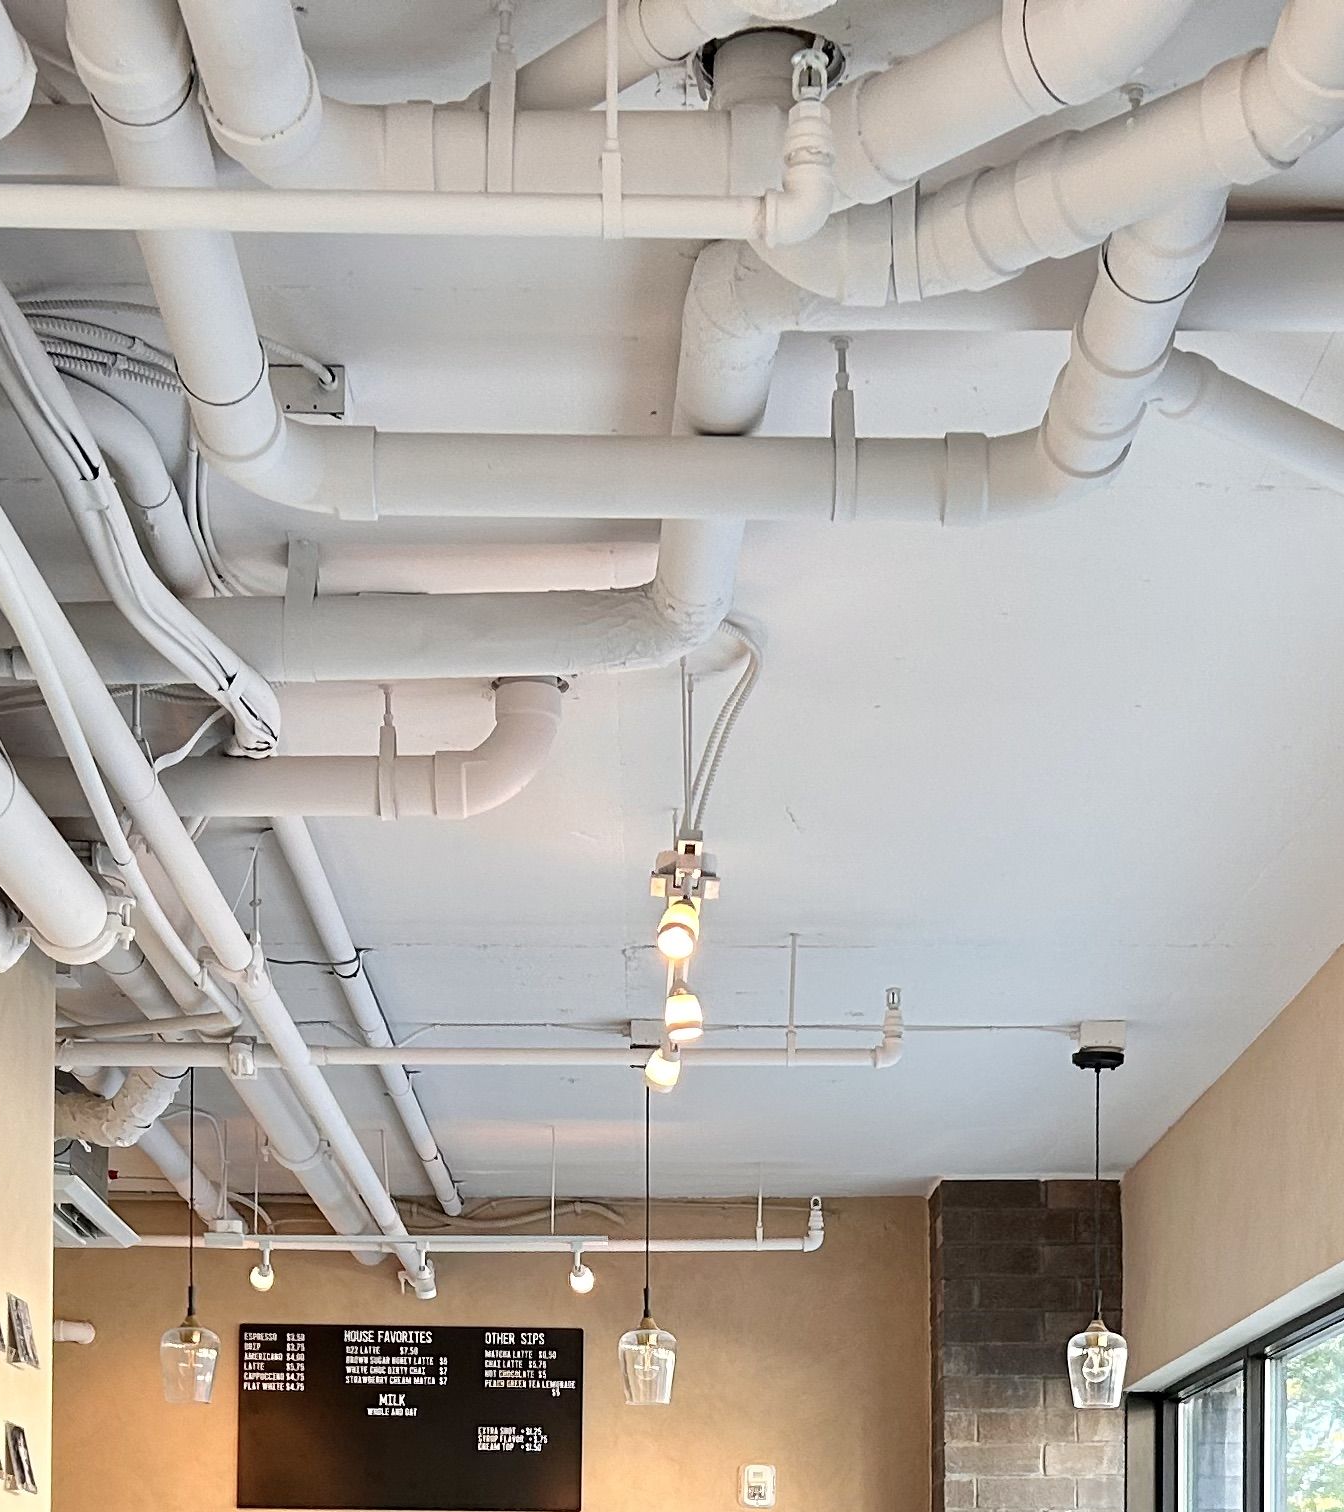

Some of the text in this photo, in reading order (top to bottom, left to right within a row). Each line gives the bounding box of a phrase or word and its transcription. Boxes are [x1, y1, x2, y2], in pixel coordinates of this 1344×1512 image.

[344, 1330, 433, 1344] HOUSE FAVORITES
[485, 1332, 545, 1345] OTHER SIPS
[359, 1345, 381, 1355] LATTE
[512, 1350, 533, 1360] LATTE
[244, 1351, 283, 1361] AMERICANO
[413, 1356, 434, 1366] LATTE
[244, 1361, 265, 1371] LATTE
[502, 1360, 523, 1369] LATTE
[345, 1365, 368, 1375] WHITE
[439, 1366, 448, 1376] $7
[439, 1376, 448, 1386] $7
[243, 1382, 261, 1391] FLAT
[261, 1382, 285, 1392] WHITE
[378, 1393, 406, 1407] MILK
[367, 1407, 417, 1417] WHOLE AND OAT
[477, 1426, 499, 1435] EXTRA
[477, 1442, 501, 1451] CREAM
[502, 1442, 514, 1451] TOP
